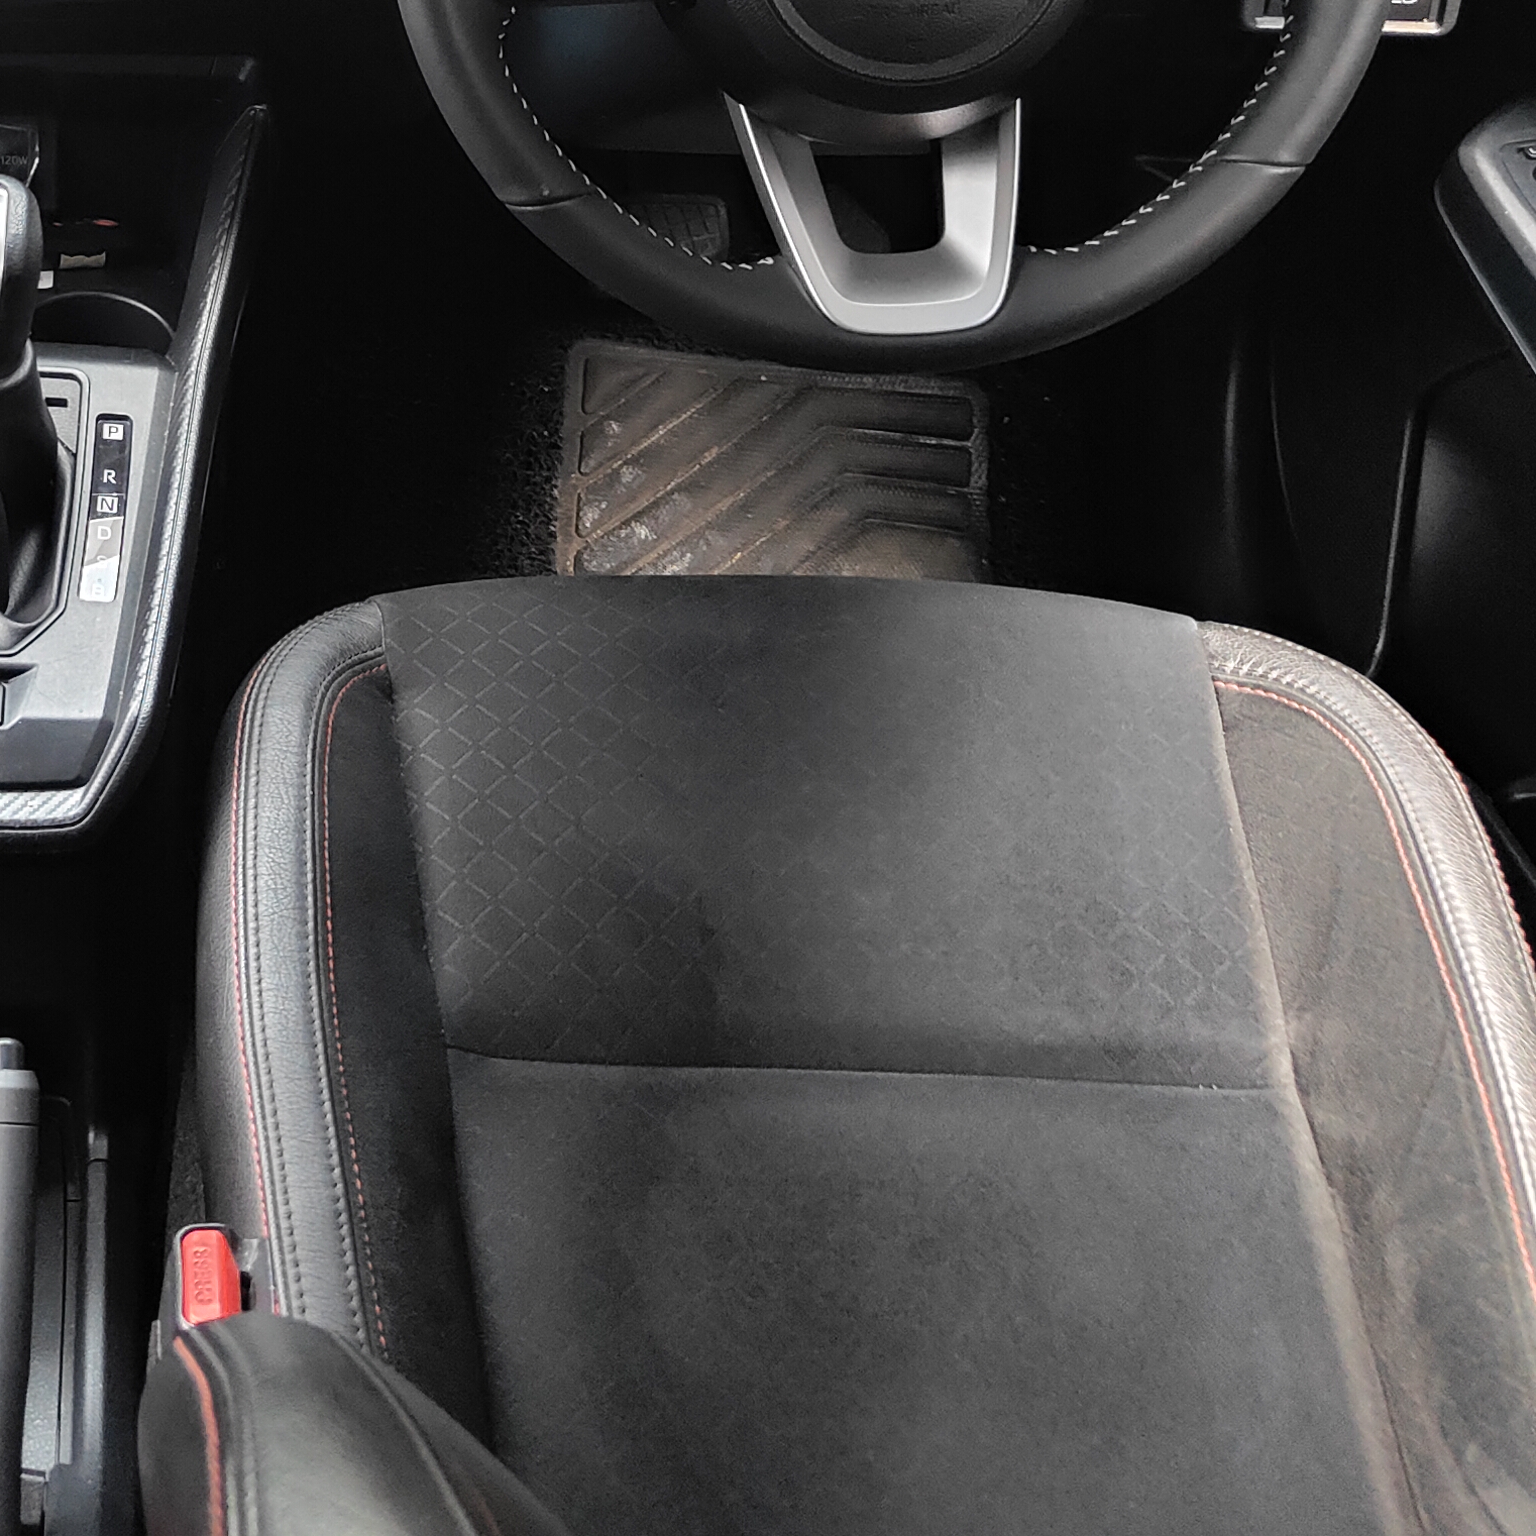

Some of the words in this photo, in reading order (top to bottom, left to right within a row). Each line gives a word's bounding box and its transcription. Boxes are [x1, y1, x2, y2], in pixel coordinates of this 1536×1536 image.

[108, 425, 119, 438] P
[103, 469, 117, 484] R
[100, 497, 114, 511] N
[97, 525, 112, 541] D
